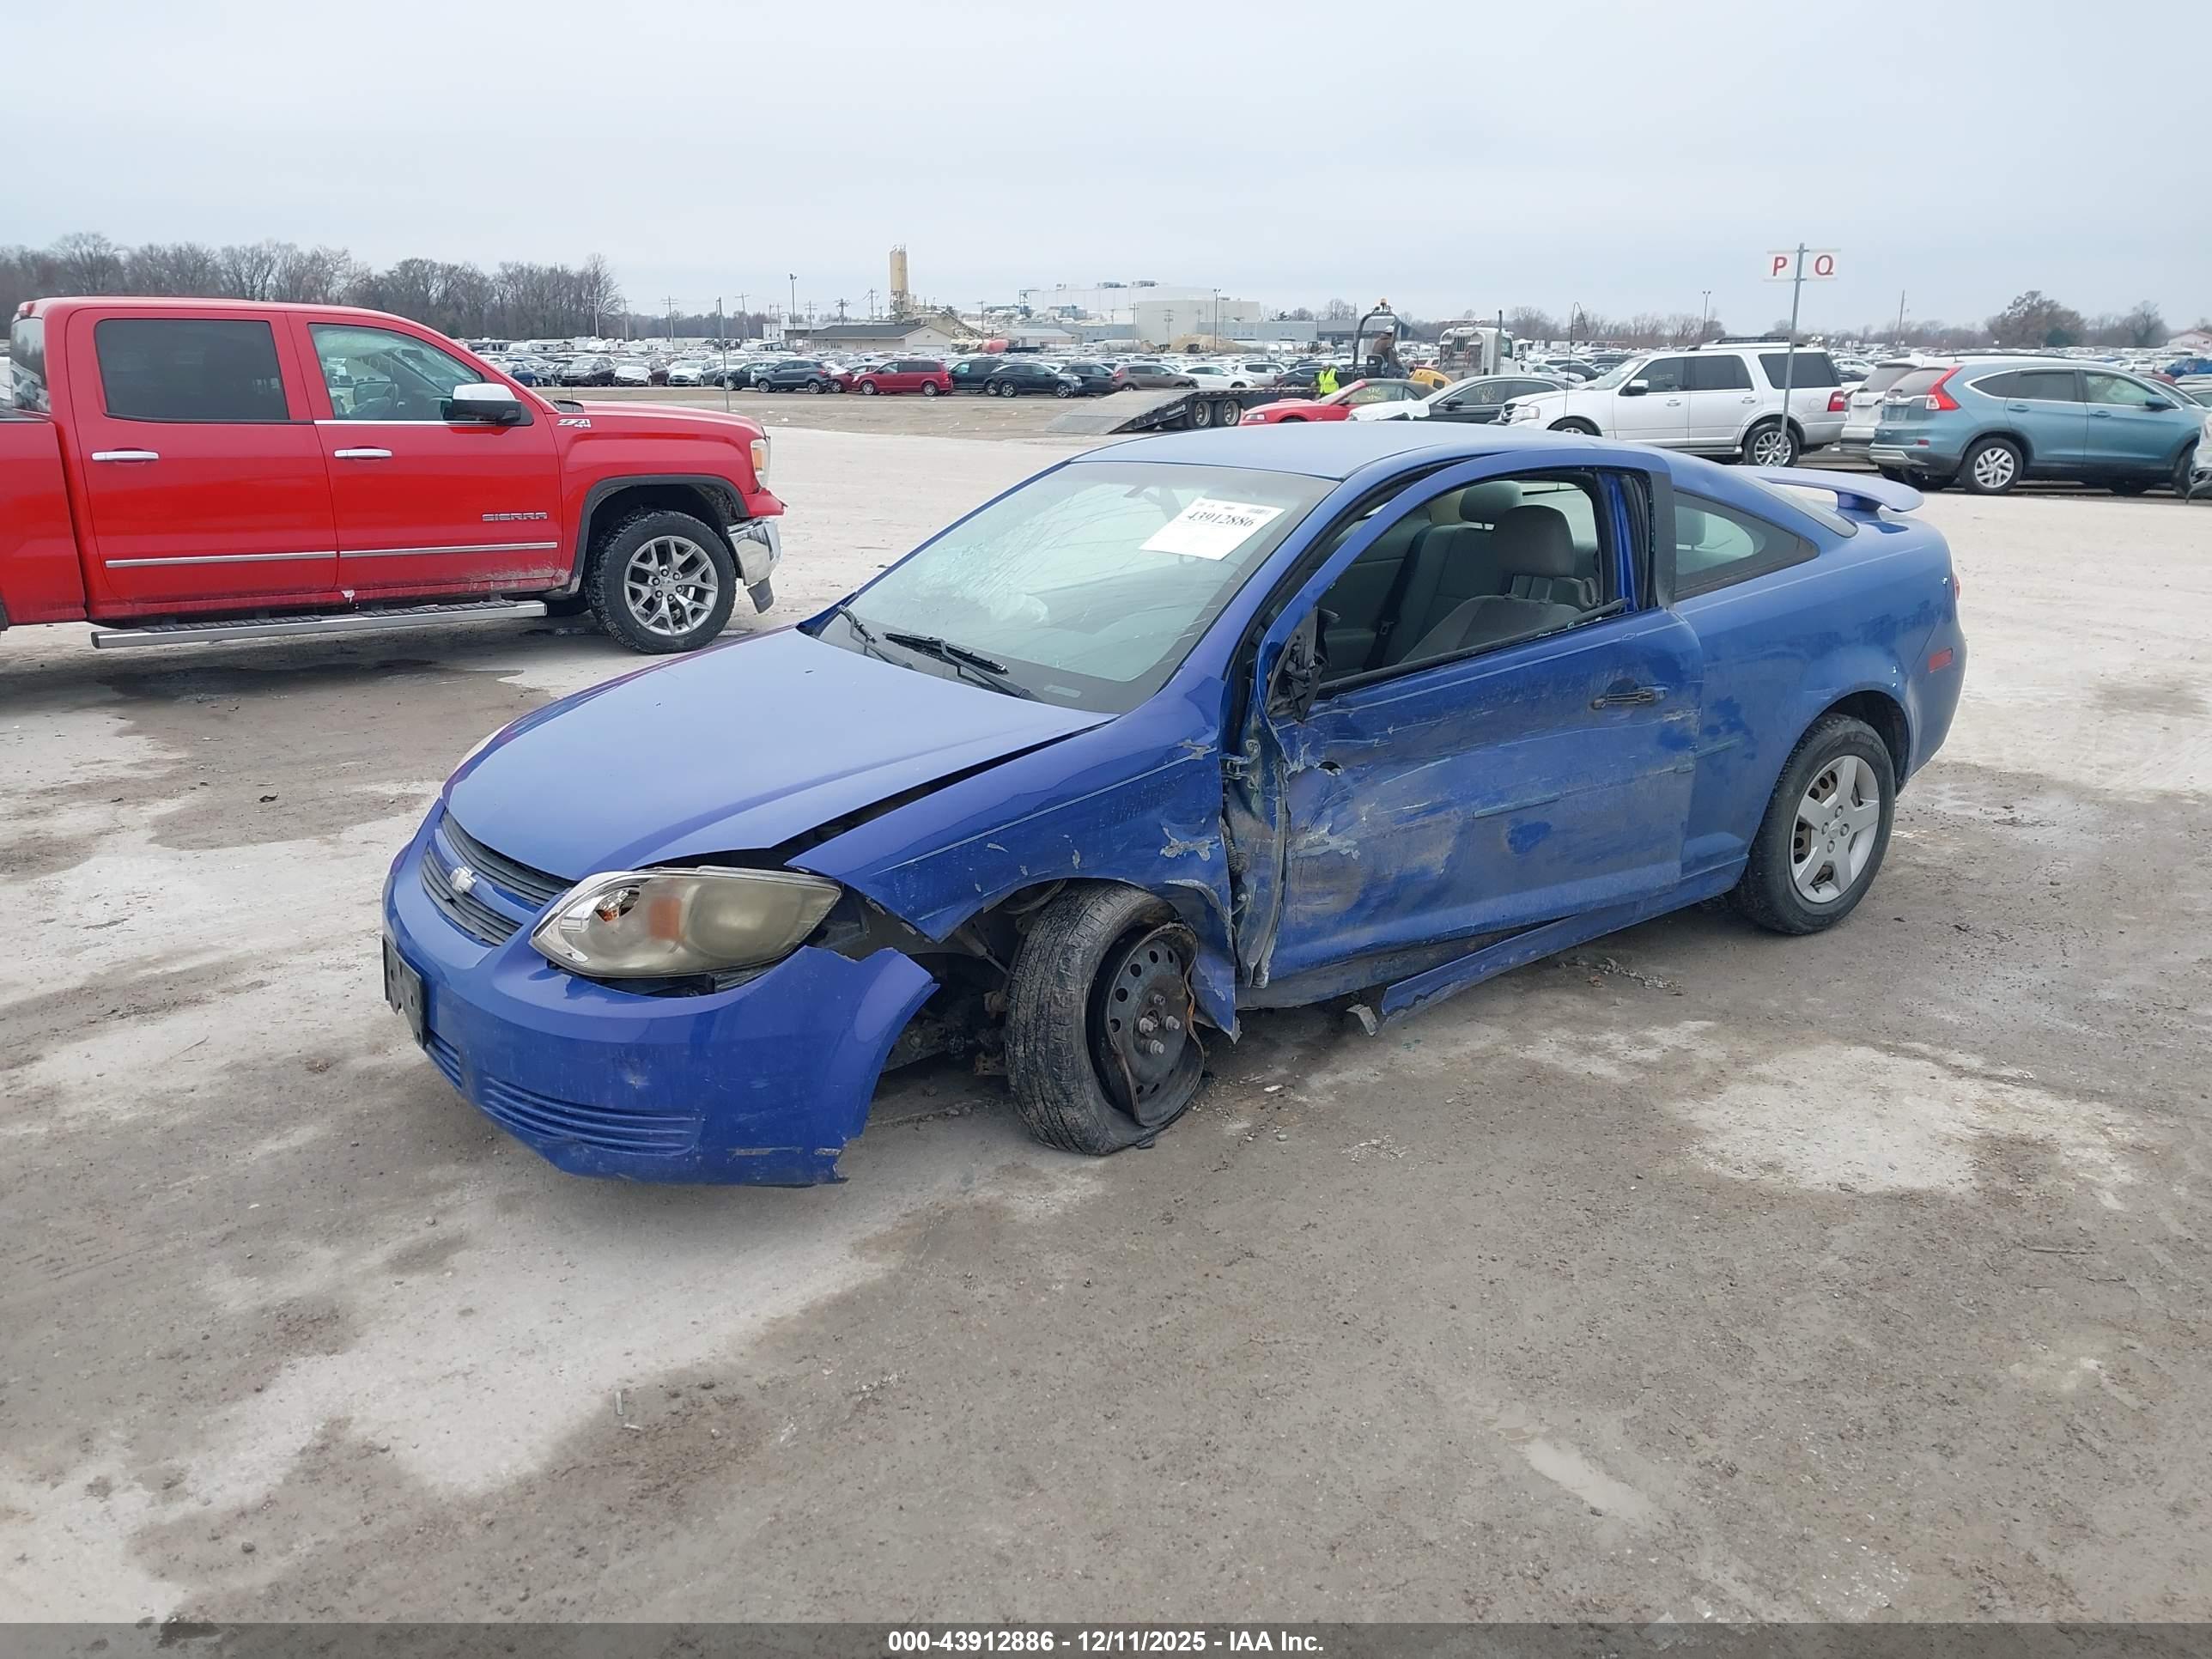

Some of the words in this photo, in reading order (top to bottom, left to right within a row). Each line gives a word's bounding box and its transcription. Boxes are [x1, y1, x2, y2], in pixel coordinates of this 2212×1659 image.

[1772, 256, 1788, 276] P
[1814, 255, 1834, 276] Q
[482, 512, 548, 521] SIERRA
[1187, 511, 1258, 527] 43912886
